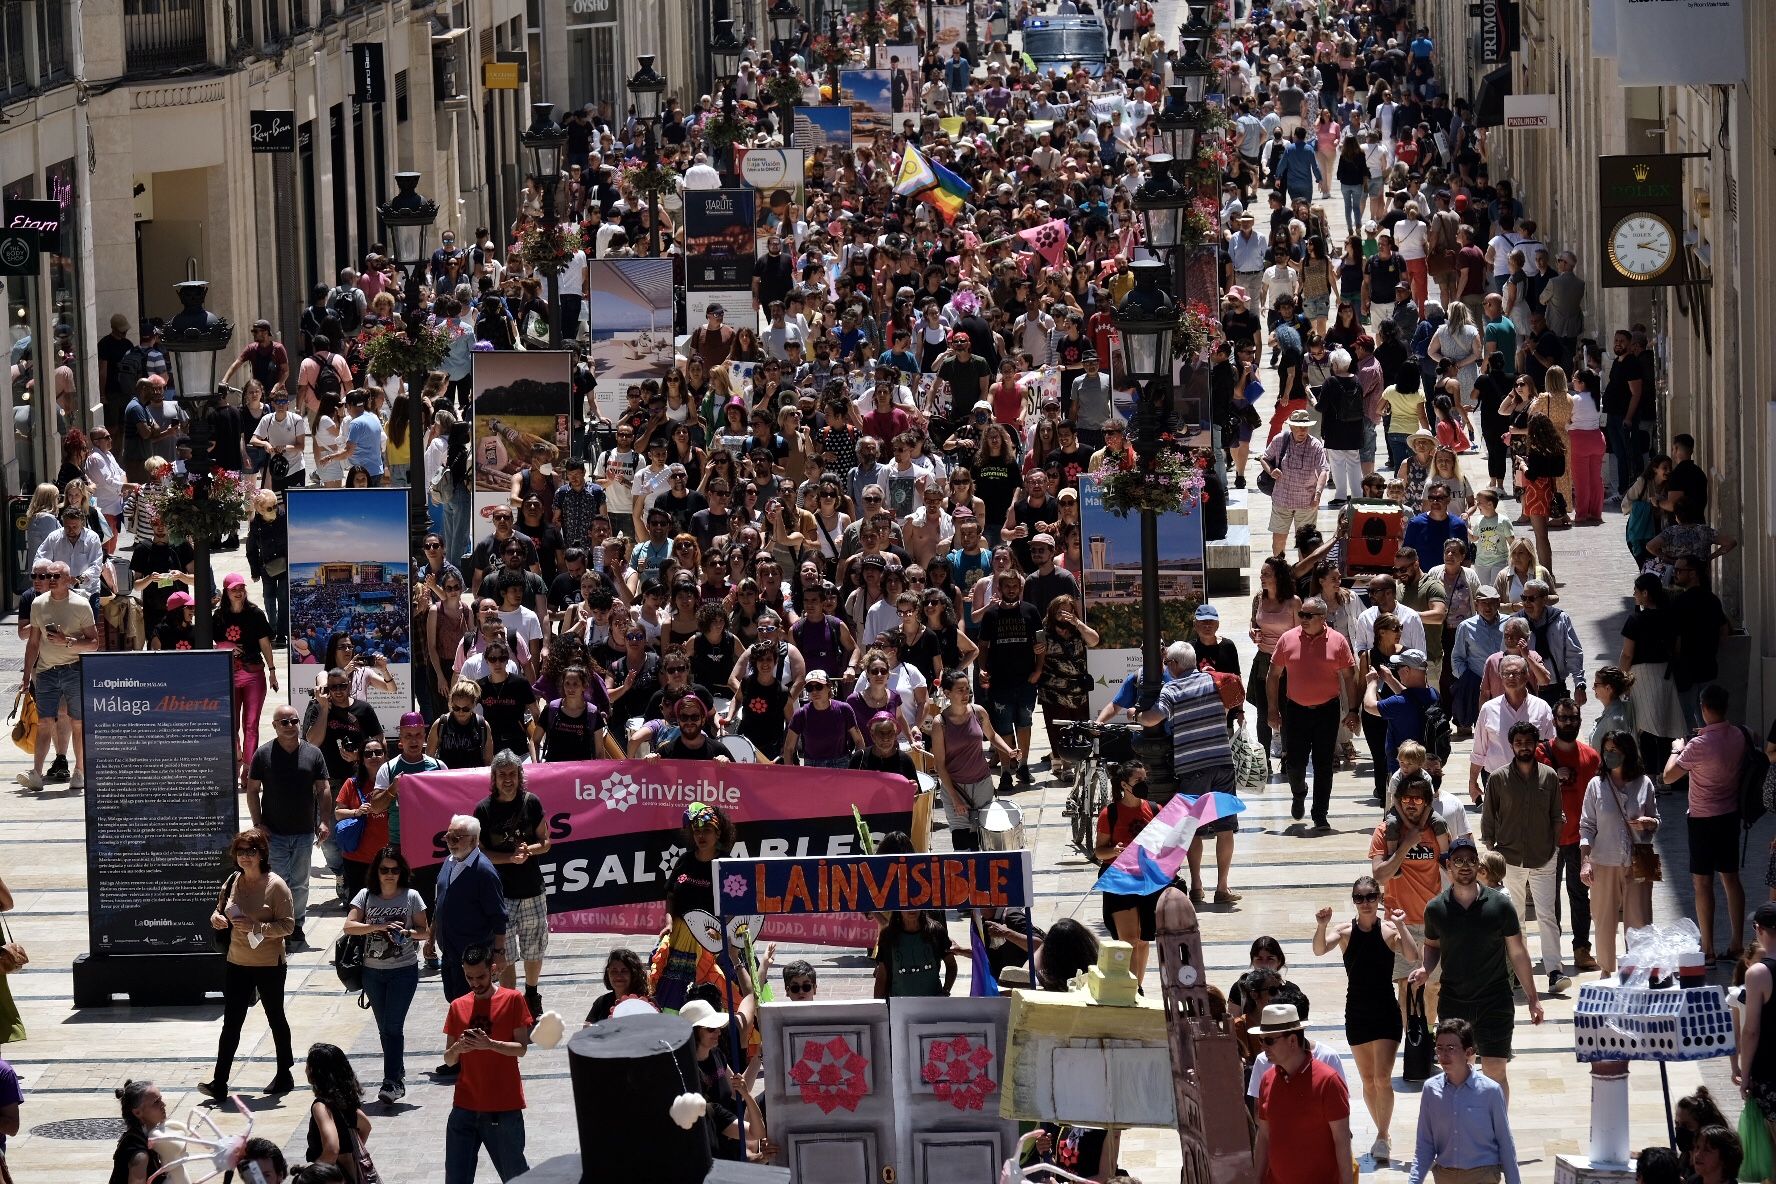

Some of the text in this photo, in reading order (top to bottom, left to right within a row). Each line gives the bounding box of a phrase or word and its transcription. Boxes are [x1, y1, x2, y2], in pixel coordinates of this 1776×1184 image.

[573, 0, 609, 14] OYSHO
[1508, 117, 1537, 127] PIKOLINOS
[250, 117, 291, 143] Ray-Ban
[705, 199, 733, 210] STARLITE
[10, 215, 58, 232] Etam
[93, 695, 220, 716] Málaga Abierta
[575, 778, 742, 803] la invisible
[366, 907, 408, 917] MURDER
[813, 923, 827, 938] LA
